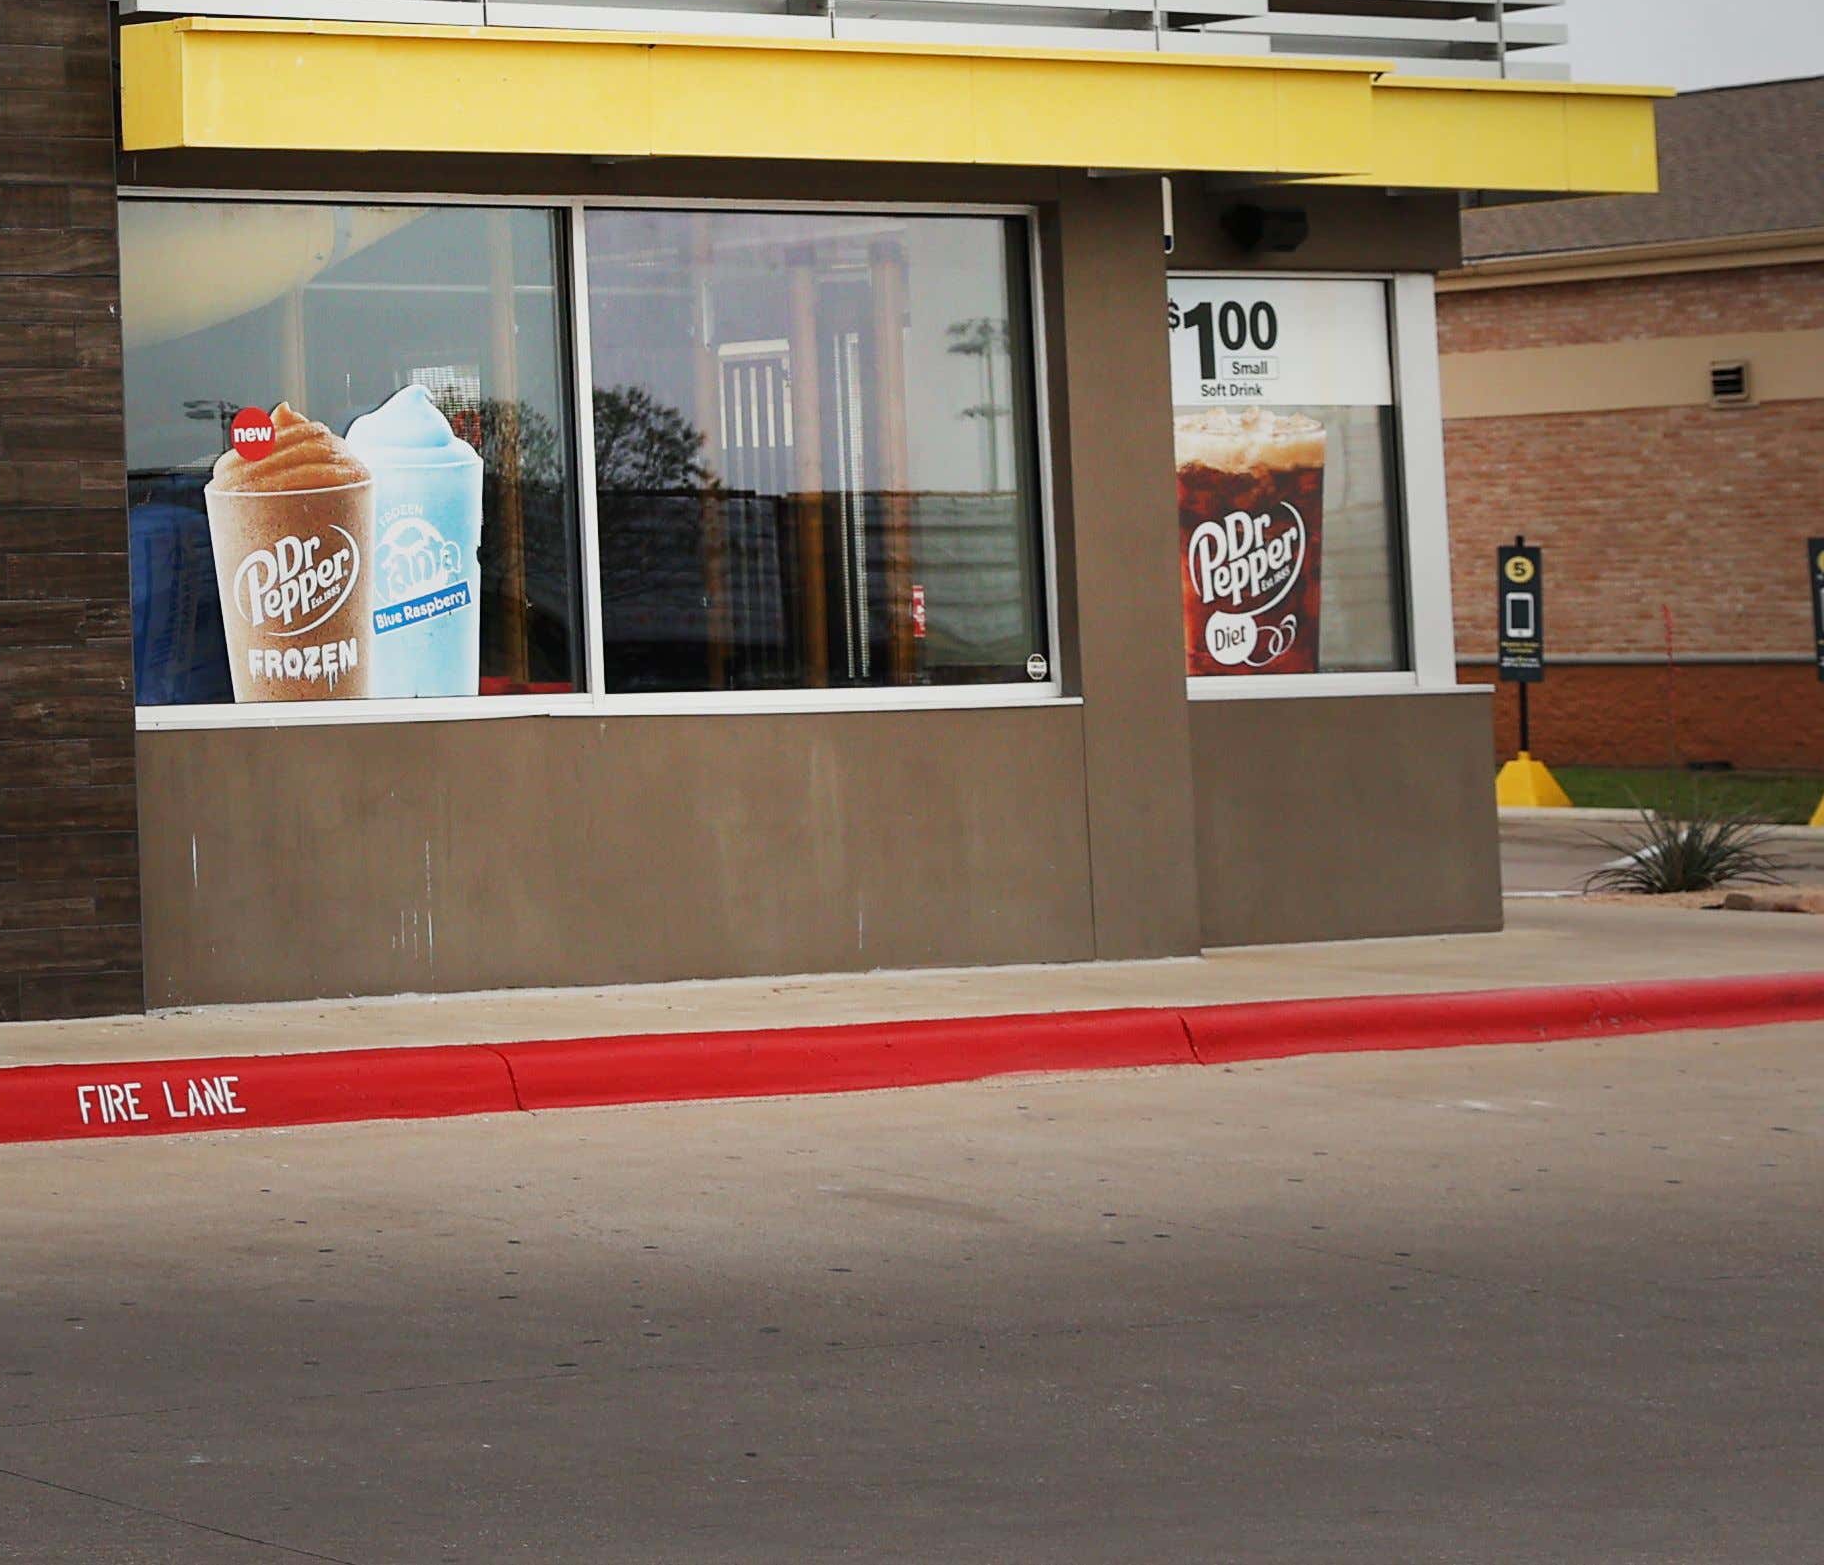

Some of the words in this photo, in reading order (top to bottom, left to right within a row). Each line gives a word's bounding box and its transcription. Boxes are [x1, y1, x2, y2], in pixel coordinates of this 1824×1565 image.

[1201, 384, 1227, 397] Soft
[1229, 383, 1263, 397] Drink
[1232, 361, 1268, 375] Small
[233, 426, 272, 443] new
[275, 535, 320, 582] Dr
[1224, 511, 1271, 561] Dr
[234, 547, 349, 627] Pepper
[1189, 521, 1298, 606] Pepper
[375, 611, 403, 629] Blue
[402, 590, 467, 620] Raspberry
[1214, 626, 1246, 651] Diet
[248, 638, 358, 688] FROZEN
[77, 1083, 149, 1124] FIRE
[162, 1076, 246, 1118] LANE
